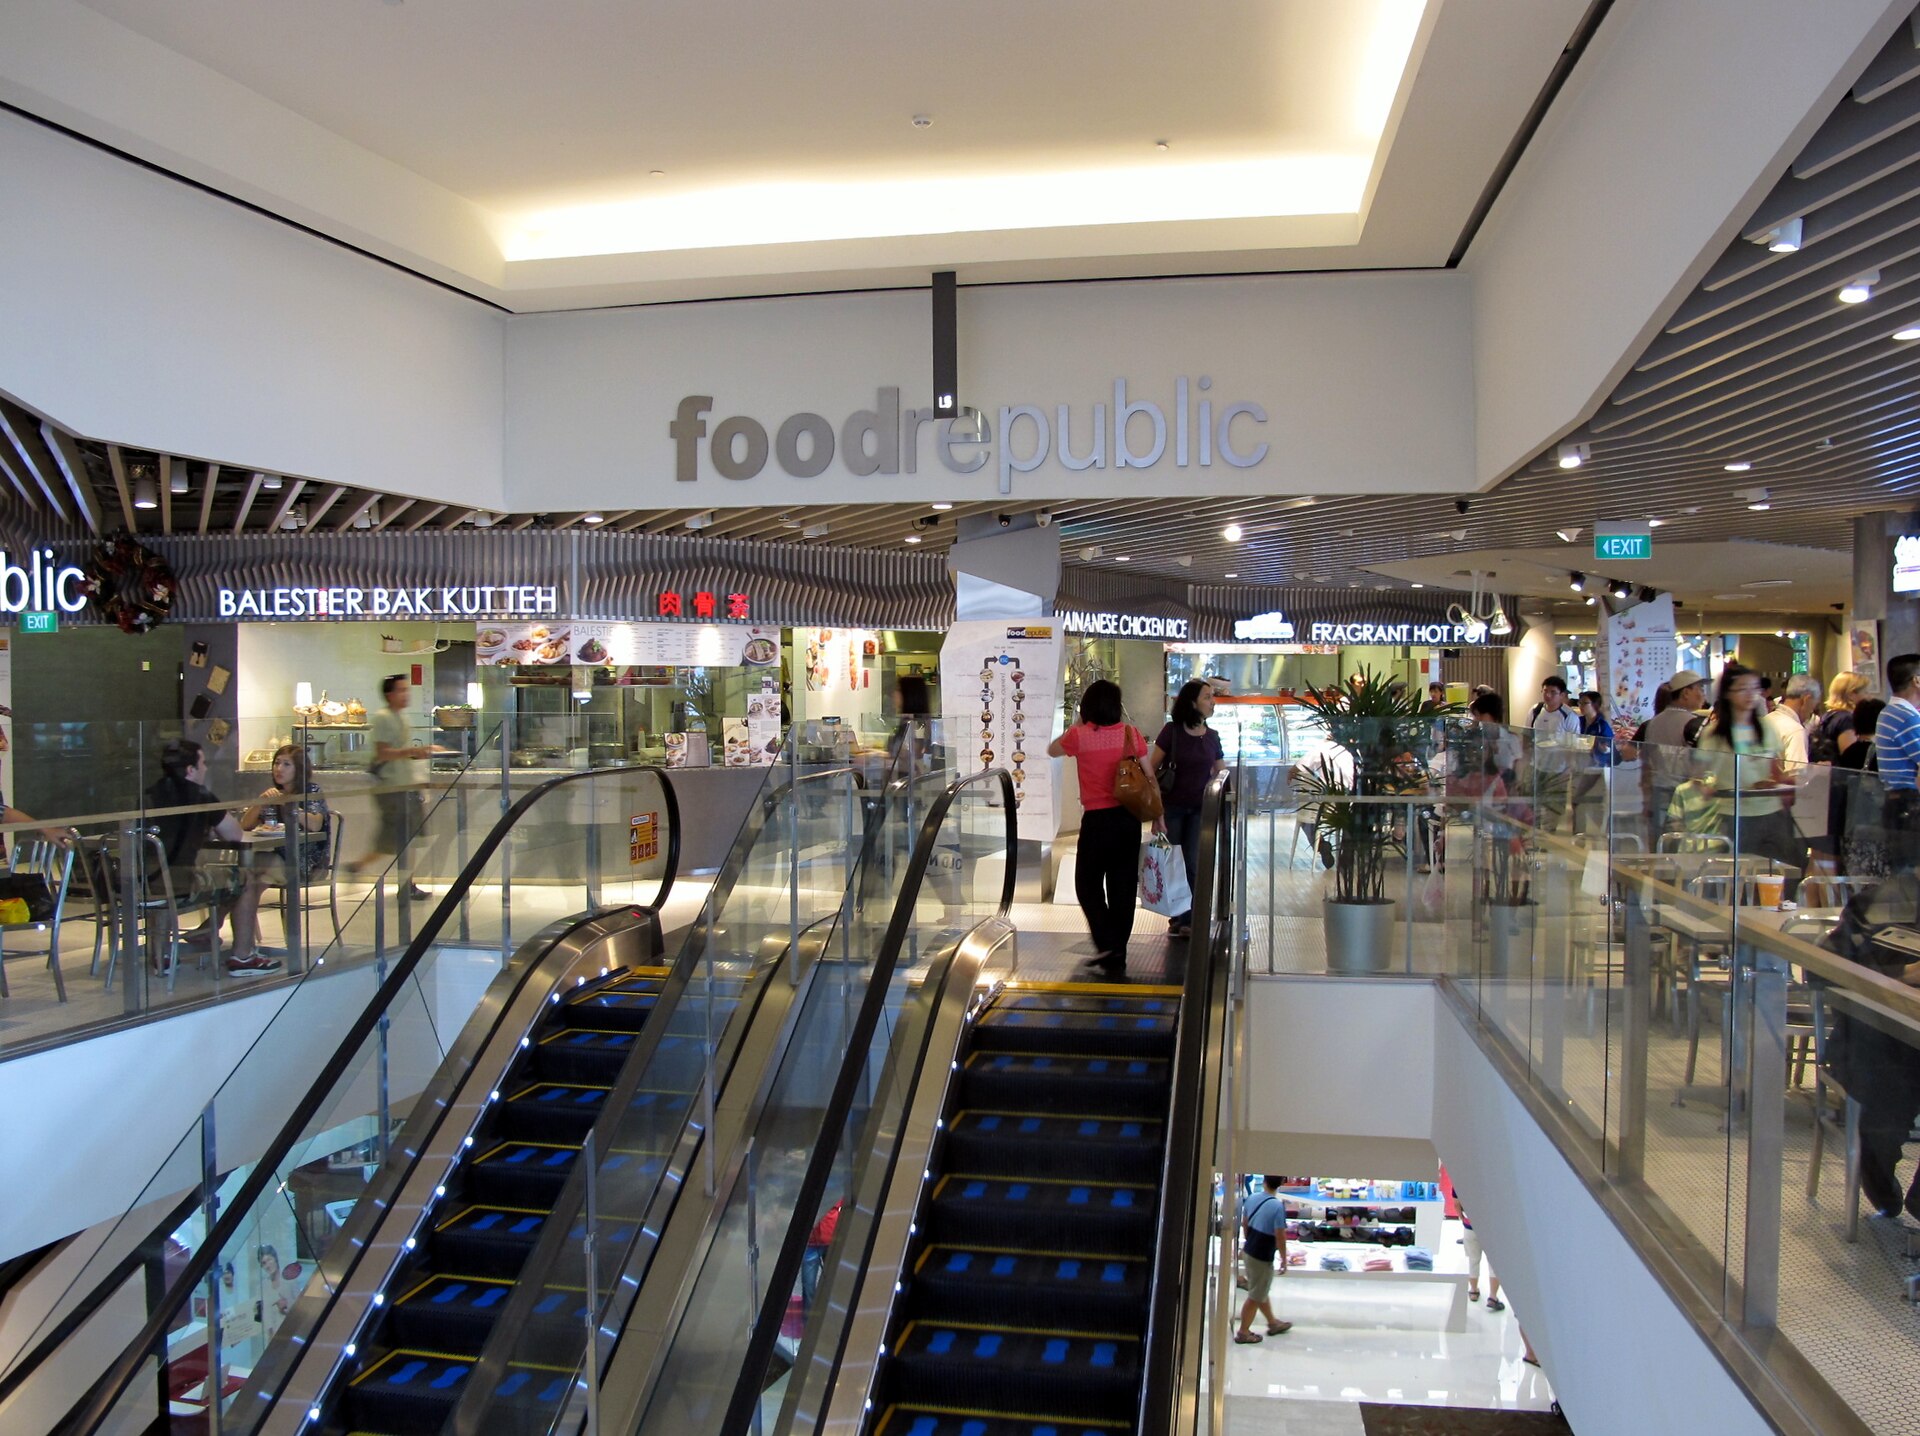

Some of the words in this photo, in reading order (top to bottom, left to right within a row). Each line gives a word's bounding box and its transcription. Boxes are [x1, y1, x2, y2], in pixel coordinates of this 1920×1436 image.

[1611, 539, 1643, 555] EXIT
[0, 549, 88, 612] blic
[220, 587, 364, 616] BALESTIER
[373, 587, 434, 615] BAK
[443, 586, 496, 614] KUT
[503, 586, 557, 614] TEH
[659, 590, 750, 619] 肉骨茶
[27, 615, 49, 629] EXIT
[1119, 614, 1164, 637] CHICKEN
[1165, 618, 1188, 639] RICE
[1311, 623, 1410, 643] FRAGRANT
[1413, 624, 1450, 643] HOT
